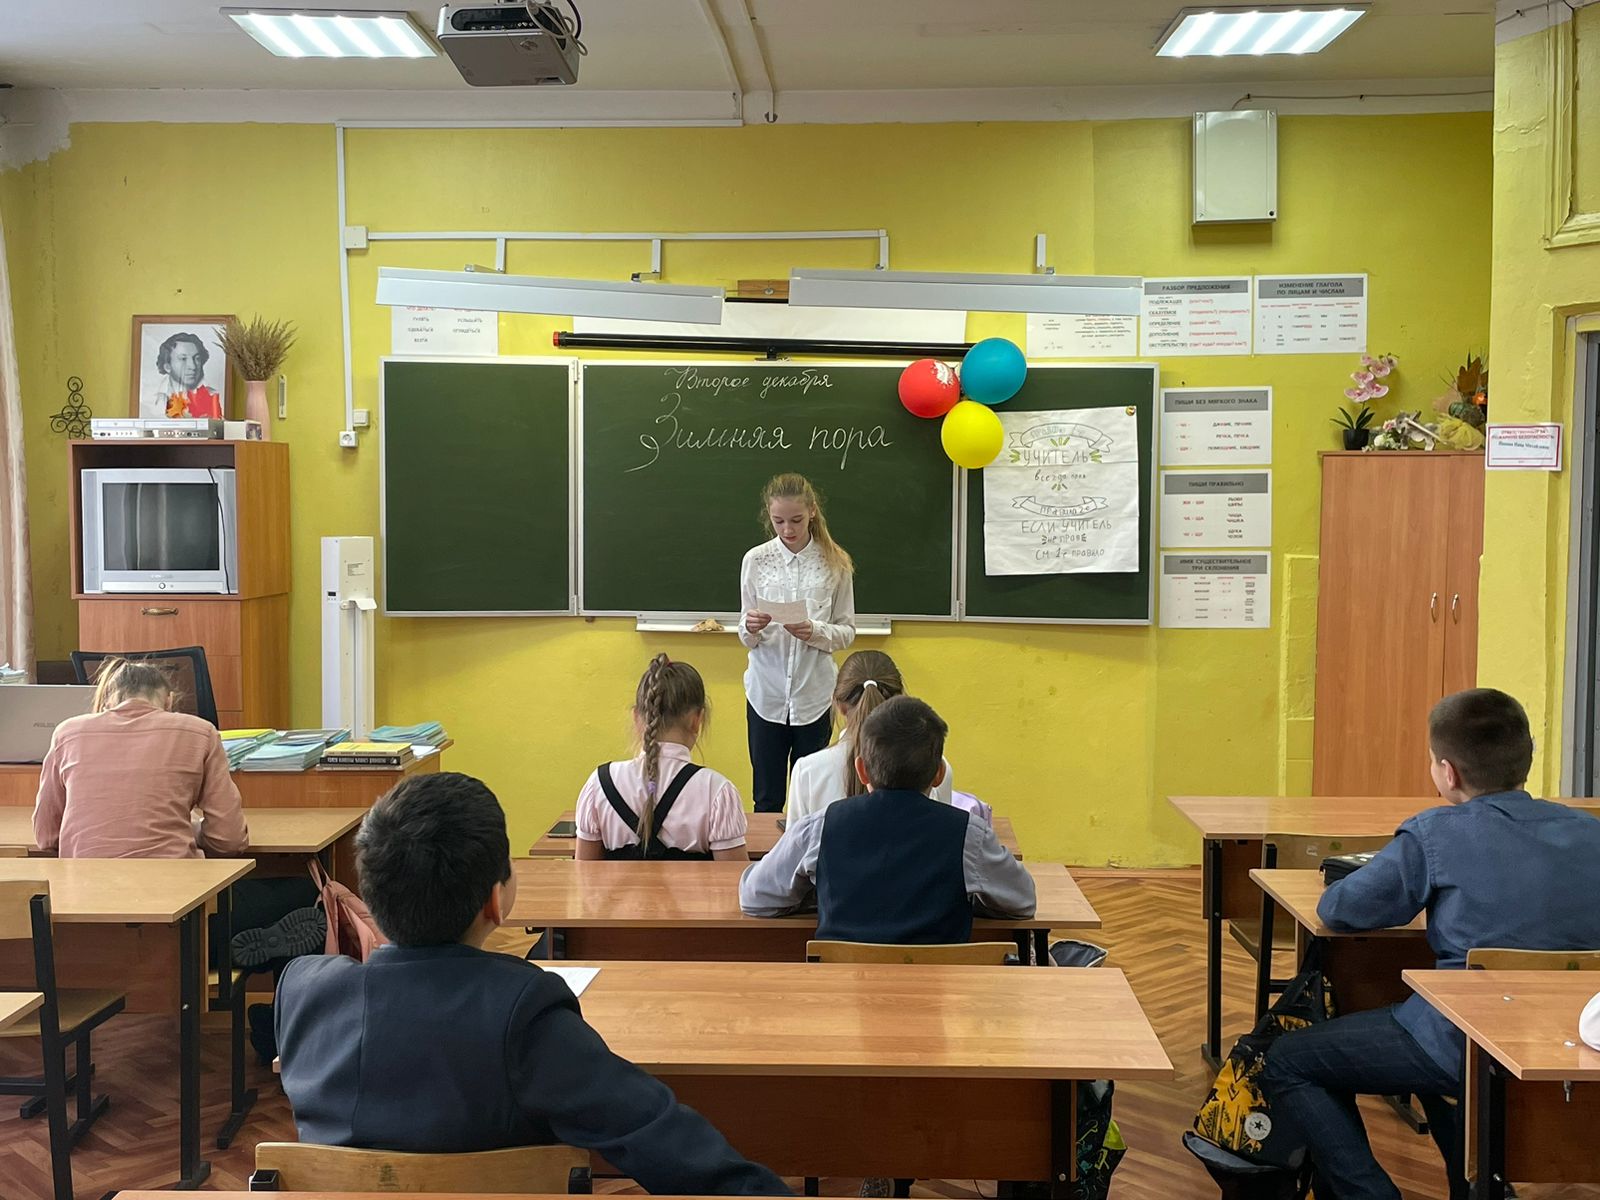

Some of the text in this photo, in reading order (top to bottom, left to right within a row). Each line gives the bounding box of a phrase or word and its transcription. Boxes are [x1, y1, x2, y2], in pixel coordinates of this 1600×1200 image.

[664, 366, 833, 399] Второе декабря
[624, 392, 894, 473] Зимняя пора
[1023, 449, 1088, 466] УЧИТЕЛЬ
[1021, 519, 1112, 534] ЕСЛИ УЧИТЕЛЬ
